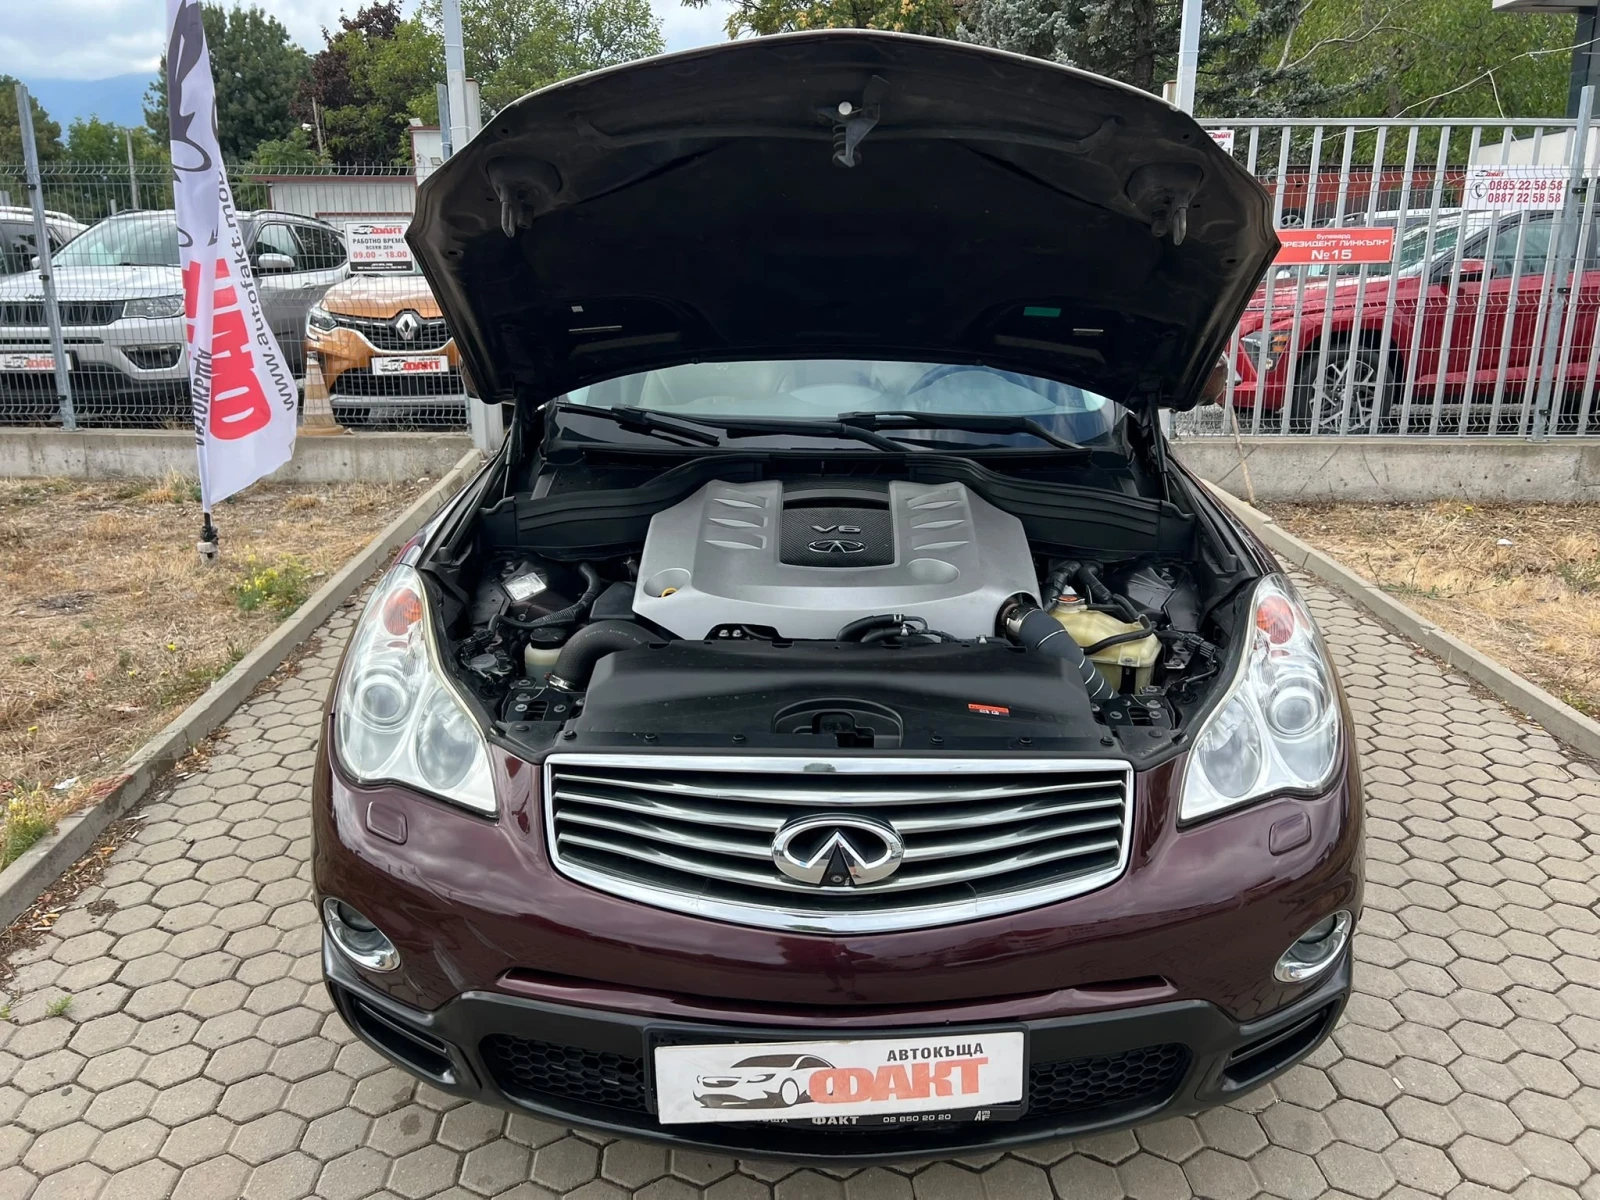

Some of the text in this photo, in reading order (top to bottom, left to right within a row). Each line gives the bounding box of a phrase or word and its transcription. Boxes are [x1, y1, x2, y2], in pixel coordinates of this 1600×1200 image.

[1489, 180, 1562, 190] 0885 22 58 58
[1488, 193, 1561, 203] 0887 22 58 58
[353, 251, 376, 259] 09.00
[811, 525, 861, 533] V6
[887, 1042, 984, 1062] АВТОКЪЩА
[808, 1056, 989, 1105] ФАКТ
[811, 1116, 860, 1125] ФАКТ
